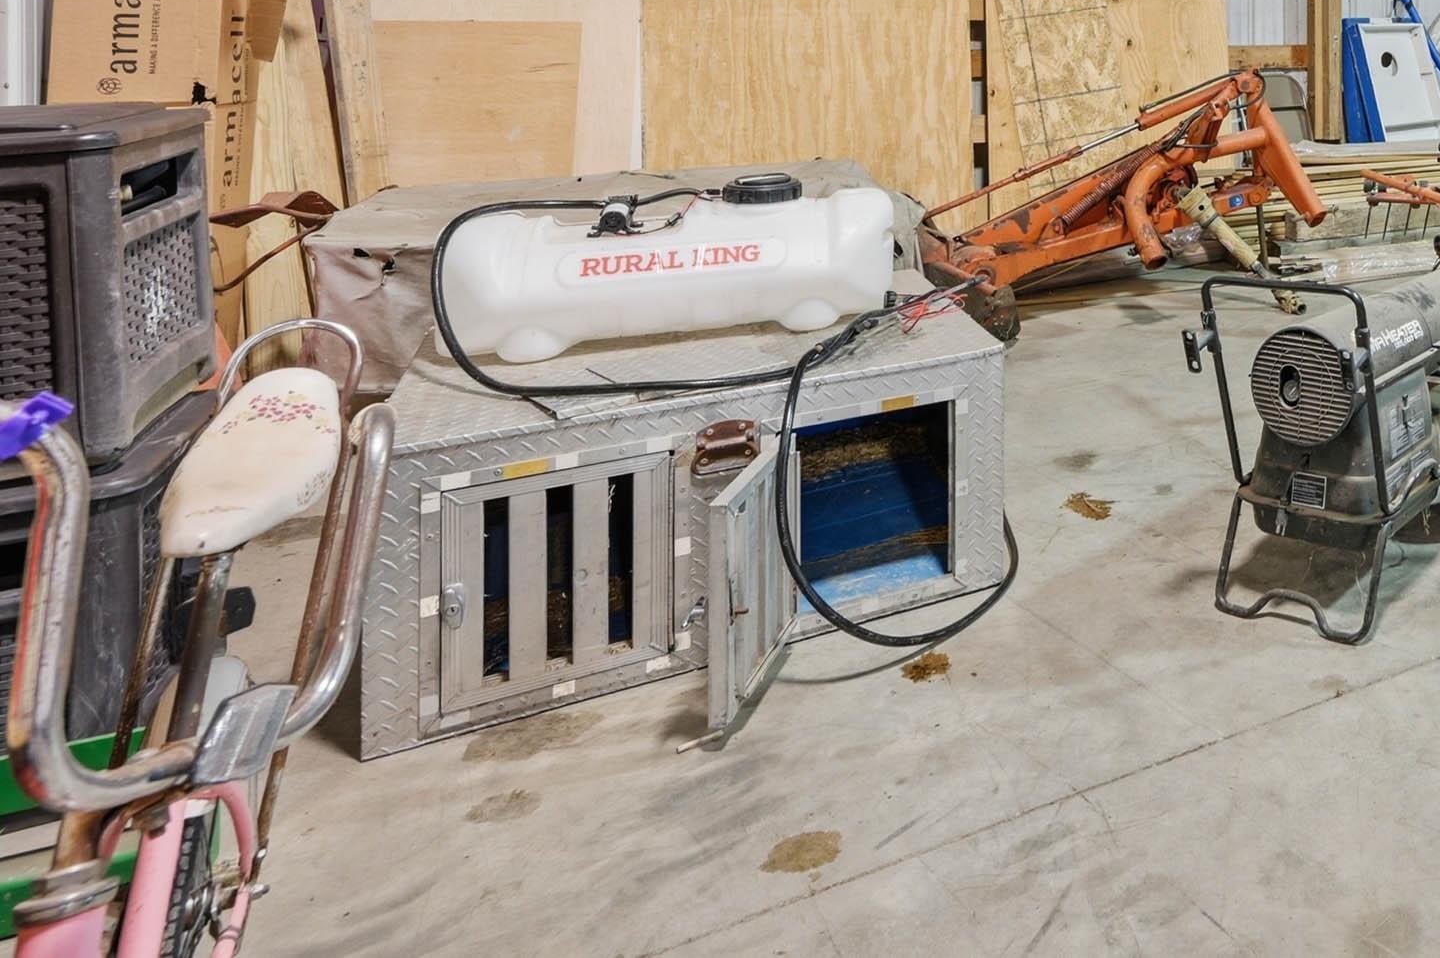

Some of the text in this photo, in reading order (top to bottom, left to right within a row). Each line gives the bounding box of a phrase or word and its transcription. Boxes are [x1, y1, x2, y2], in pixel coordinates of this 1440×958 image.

[151, 3, 161, 42] DIFFERENCE
[579, 244, 761, 277] RURAL KING
